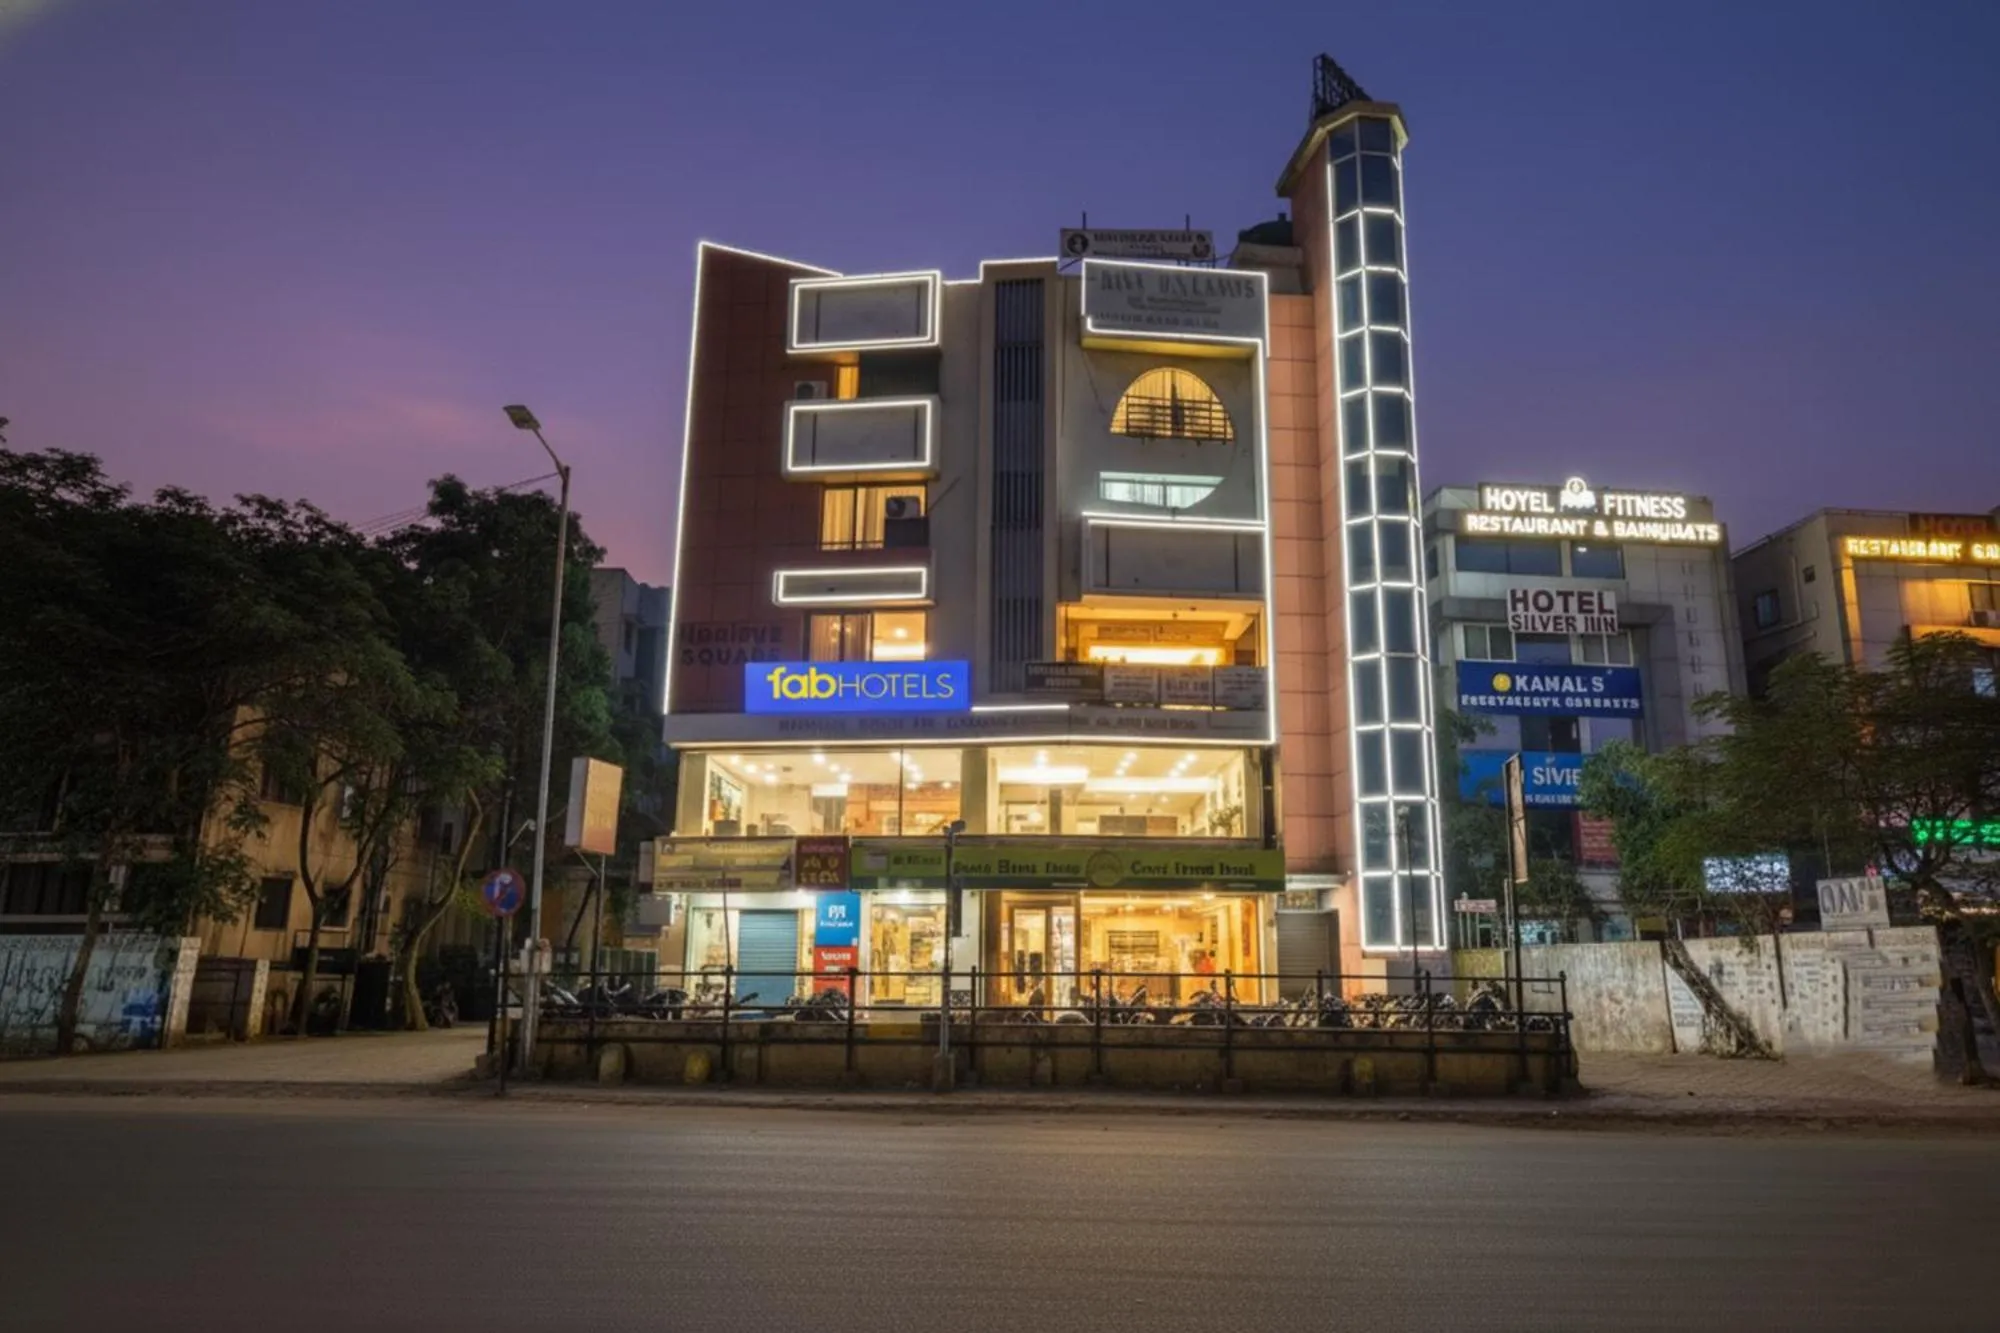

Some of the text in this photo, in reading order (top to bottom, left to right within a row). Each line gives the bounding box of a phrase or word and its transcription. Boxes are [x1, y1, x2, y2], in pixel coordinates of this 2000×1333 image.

[1604, 494, 1686, 518] FITNESS
[1510, 589, 1613, 615] HOTEL
[1511, 614, 1577, 632] SILVER
[767, 667, 955, 700] fabHOTELS
